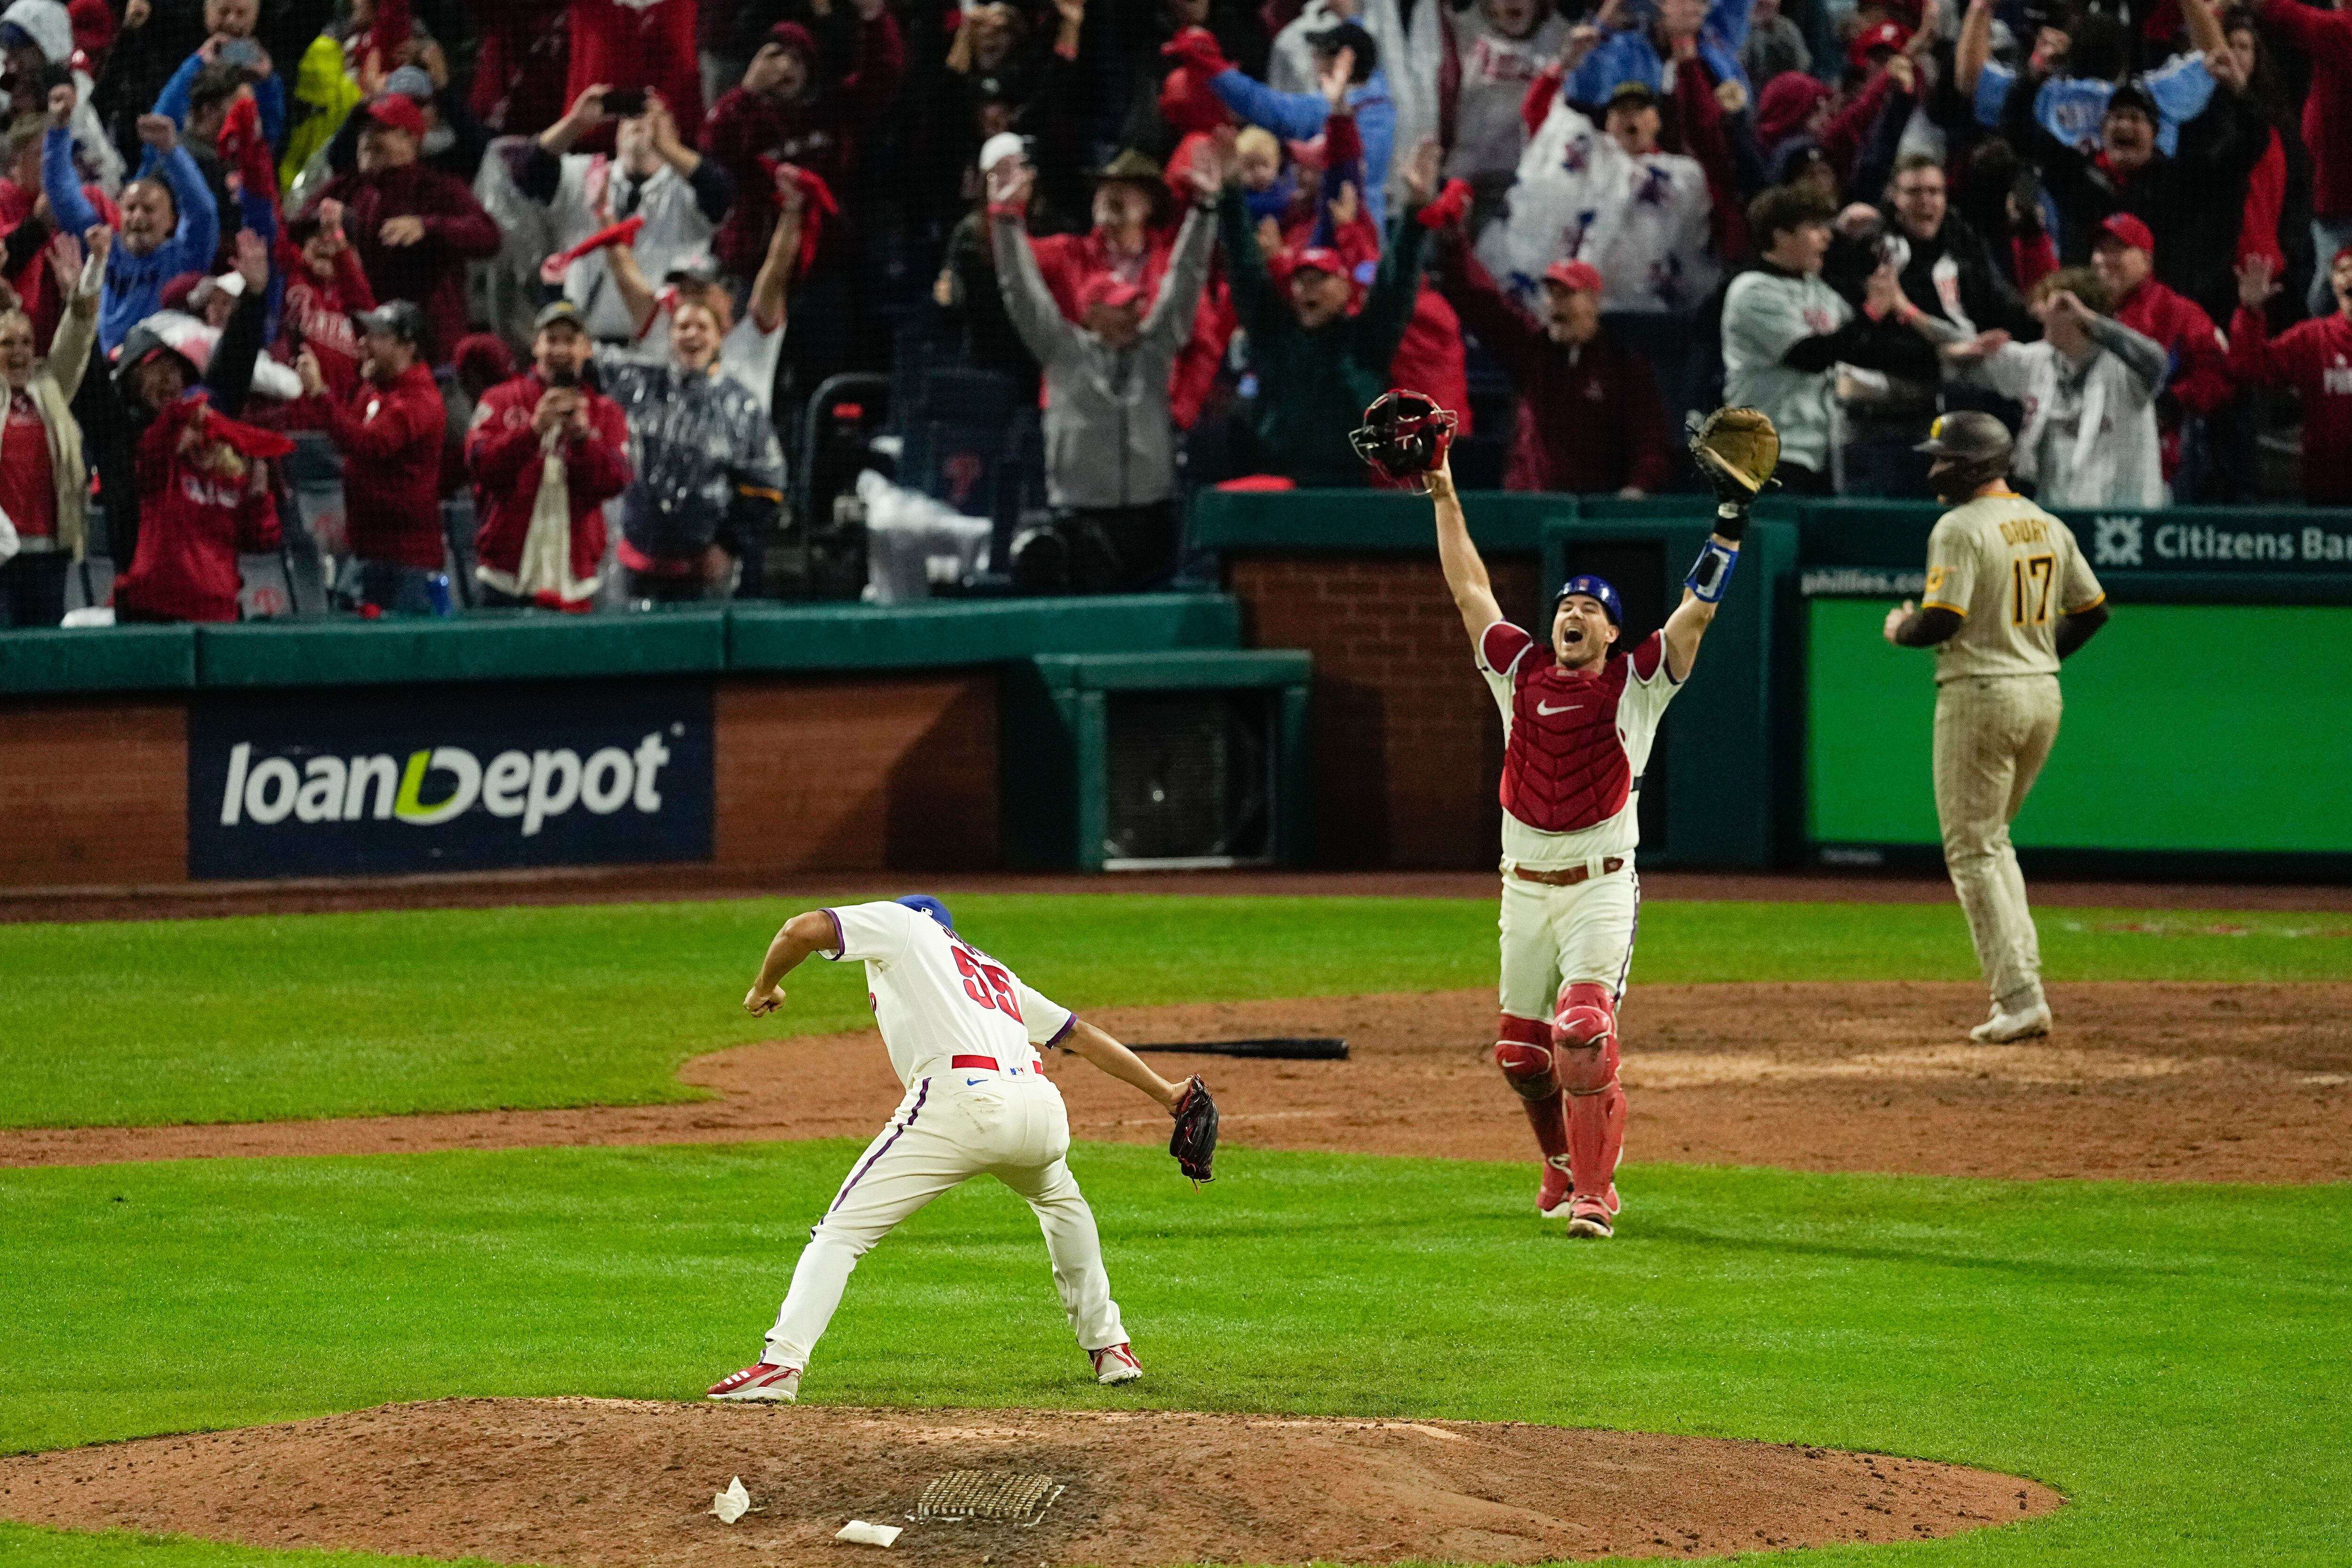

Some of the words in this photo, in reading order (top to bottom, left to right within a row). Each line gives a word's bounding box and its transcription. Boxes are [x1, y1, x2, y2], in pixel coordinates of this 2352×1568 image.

[2153, 524, 2295, 560] Citizens
[2302, 525, 2352, 561] Ba
[1801, 568, 1926, 597] phillies.co
[2012, 553, 2055, 627] 17
[220, 732, 670, 837] loanDepot
[950, 945, 1025, 1026] 55
